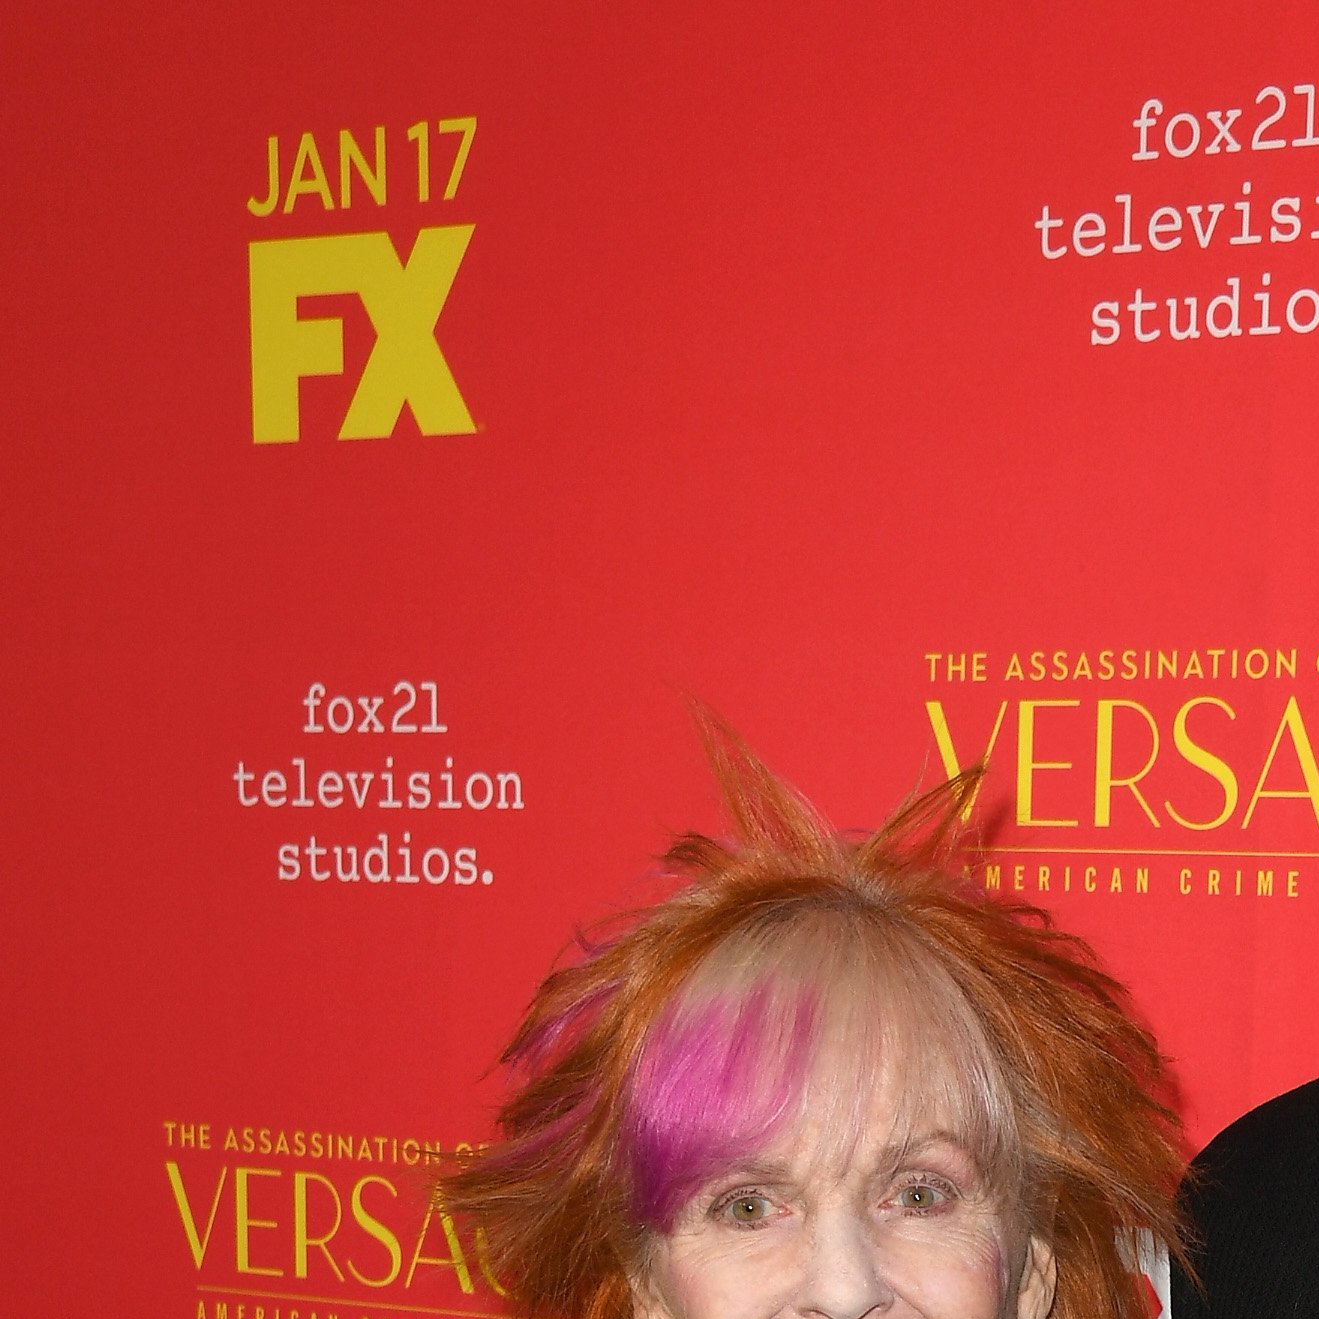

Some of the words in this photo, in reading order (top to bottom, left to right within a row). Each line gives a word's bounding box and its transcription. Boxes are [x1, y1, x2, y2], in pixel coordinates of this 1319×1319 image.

[247, 125, 387, 217] JAN
[407, 116, 478, 203] 17
[249, 223, 479, 444] FX
[925, 652, 988, 682] THE
[1004, 648, 1297, 682] ASSASSINATION
[302, 681, 448, 734] fox21
[233, 757, 525, 810] television
[278, 833, 494, 885] studios.
[1179, 868, 1299, 897] CRIME
[164, 1121, 211, 1149] THE
[224, 1127, 441, 1168] ASSASSINATION
